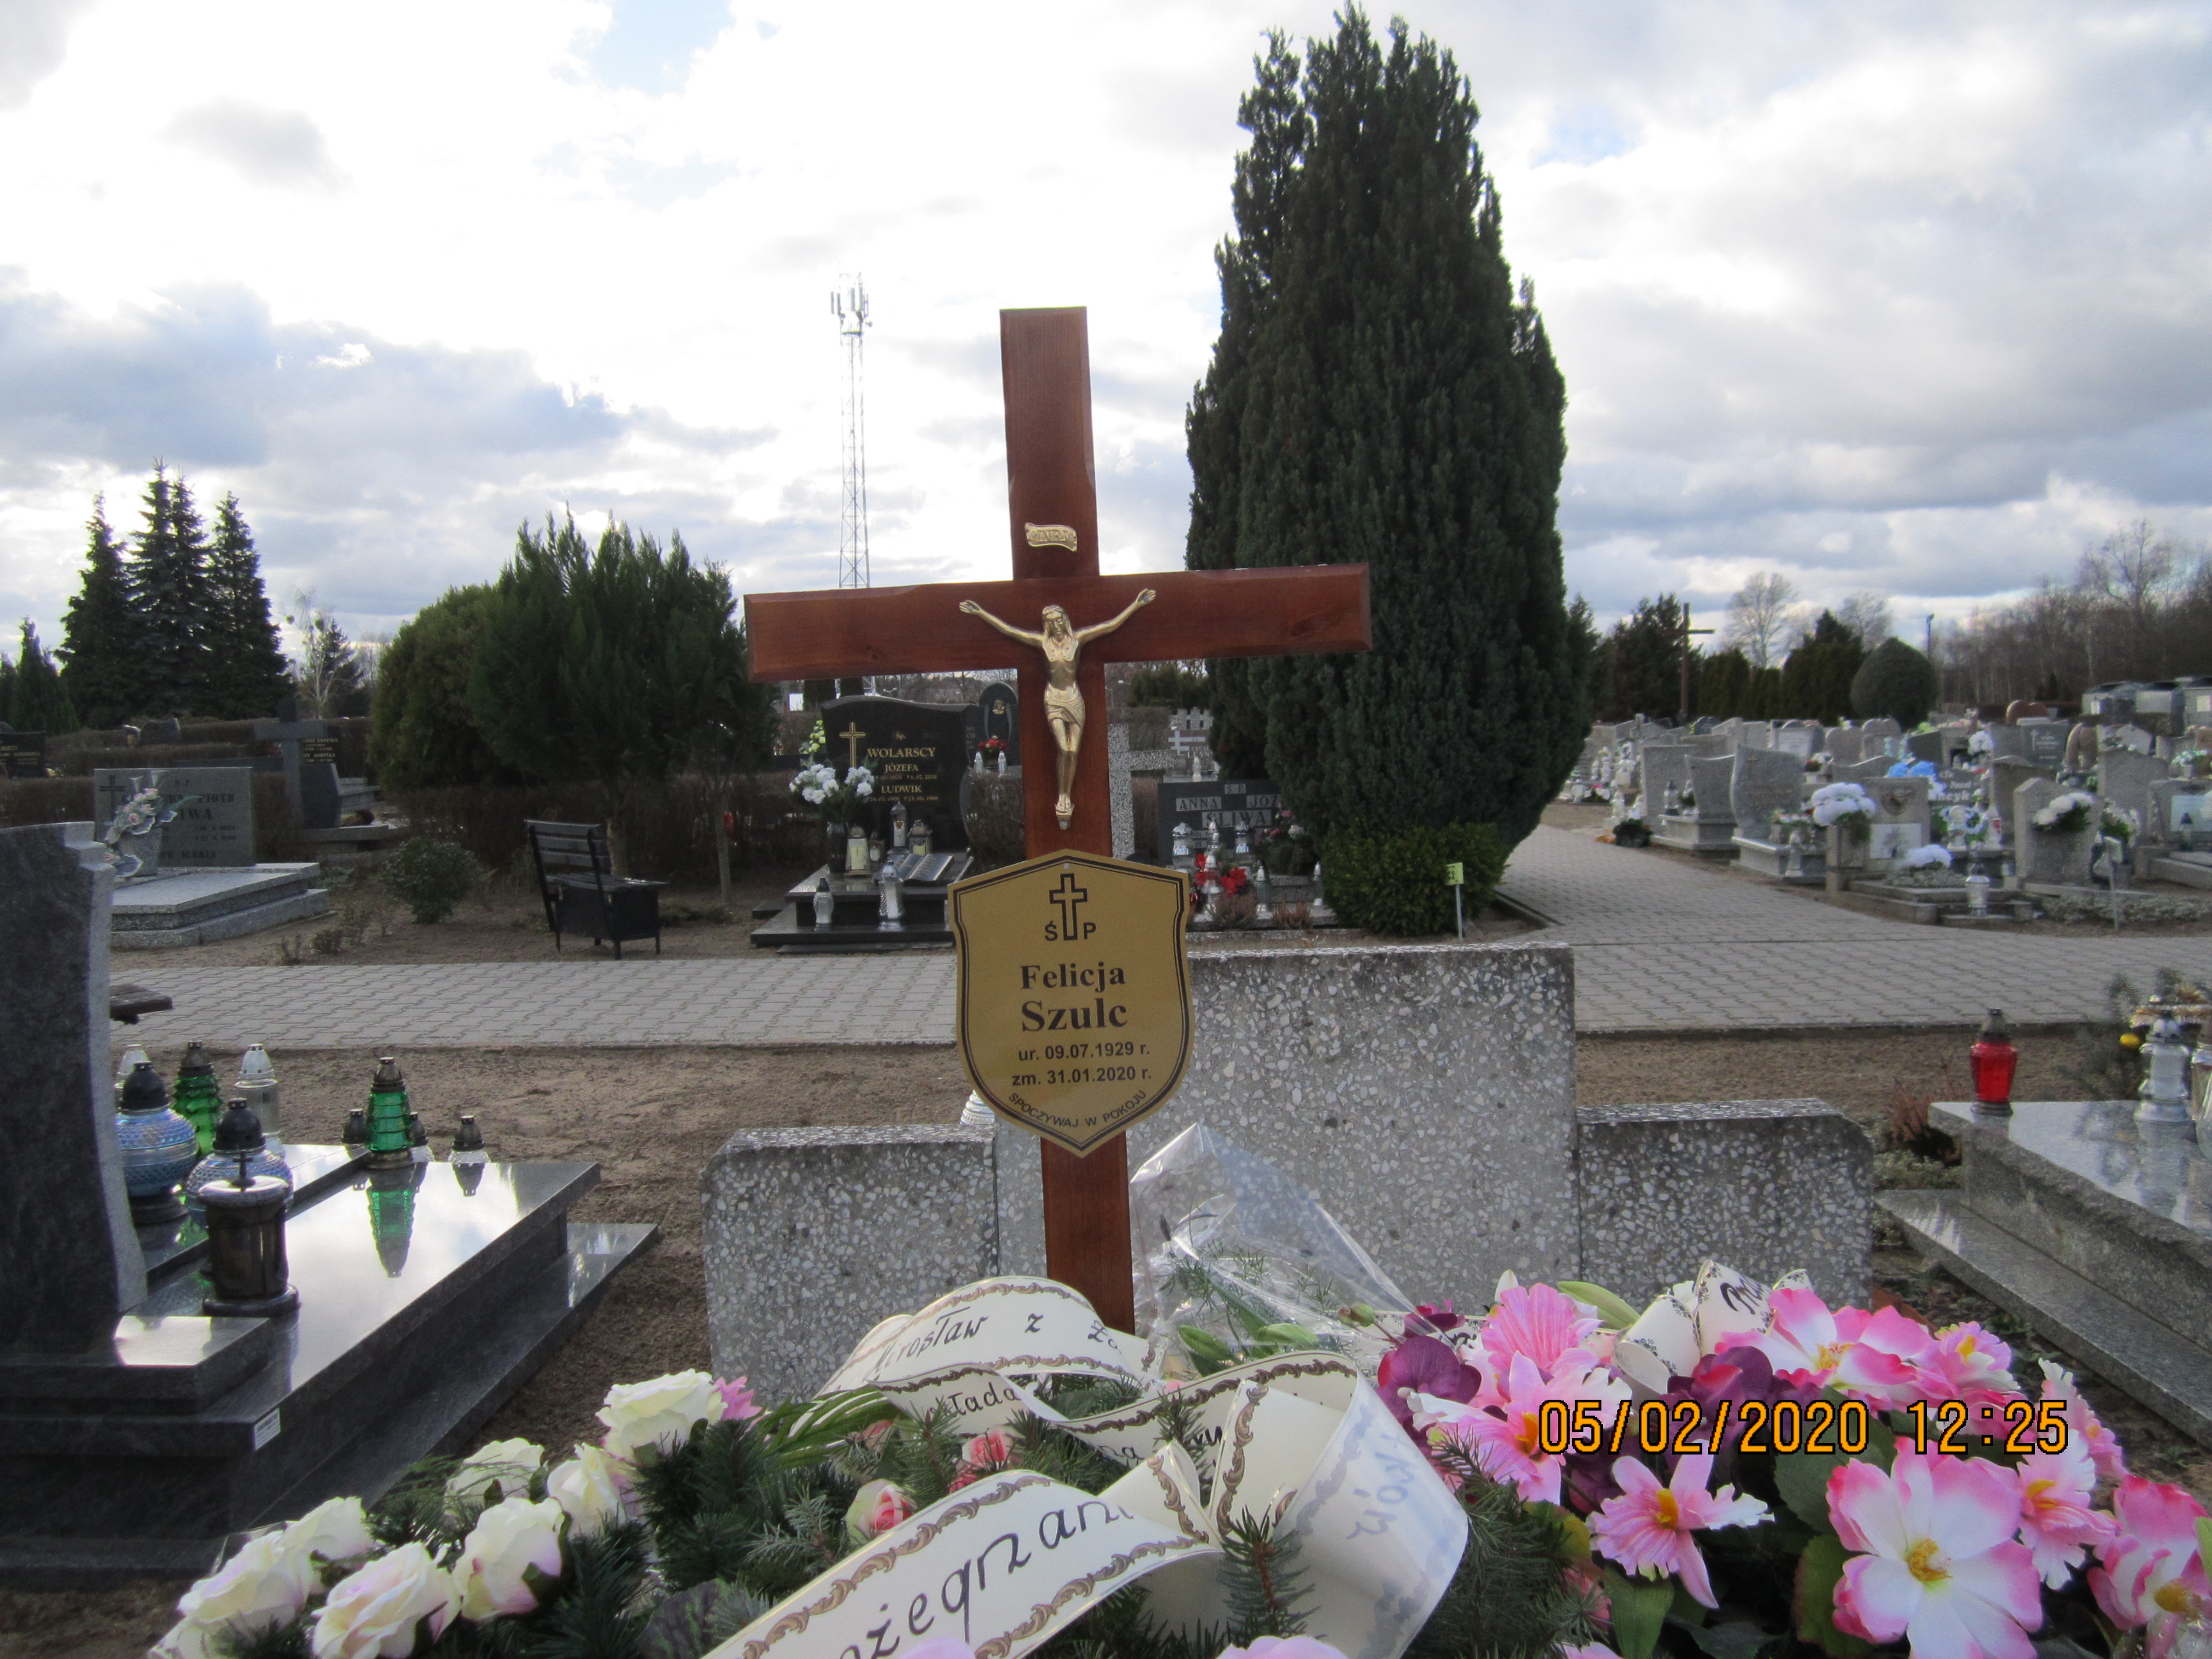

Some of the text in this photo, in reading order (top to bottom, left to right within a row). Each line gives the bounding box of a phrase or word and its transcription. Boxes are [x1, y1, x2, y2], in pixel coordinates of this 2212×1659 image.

[866, 747, 936, 758] WOLARSCY
[884, 763, 919, 773] JÓZEFA
[881, 785, 922, 793] LUDWIK
[1179, 797, 1218, 811] ANNA
[1044, 920, 1097, 941] Ś P
[1019, 961, 1125, 993] Felicja
[1020, 997, 1128, 1032] Szulc
[1018, 1042, 1150, 1061] ur. 09.07.1929 r.
[1012, 1066, 1151, 1086] zm. 31.01.2020 r.
[1008, 1090, 1146, 1128] SPOCZYWAJ W POKOJU
[1025, 1313, 1045, 1334] z
